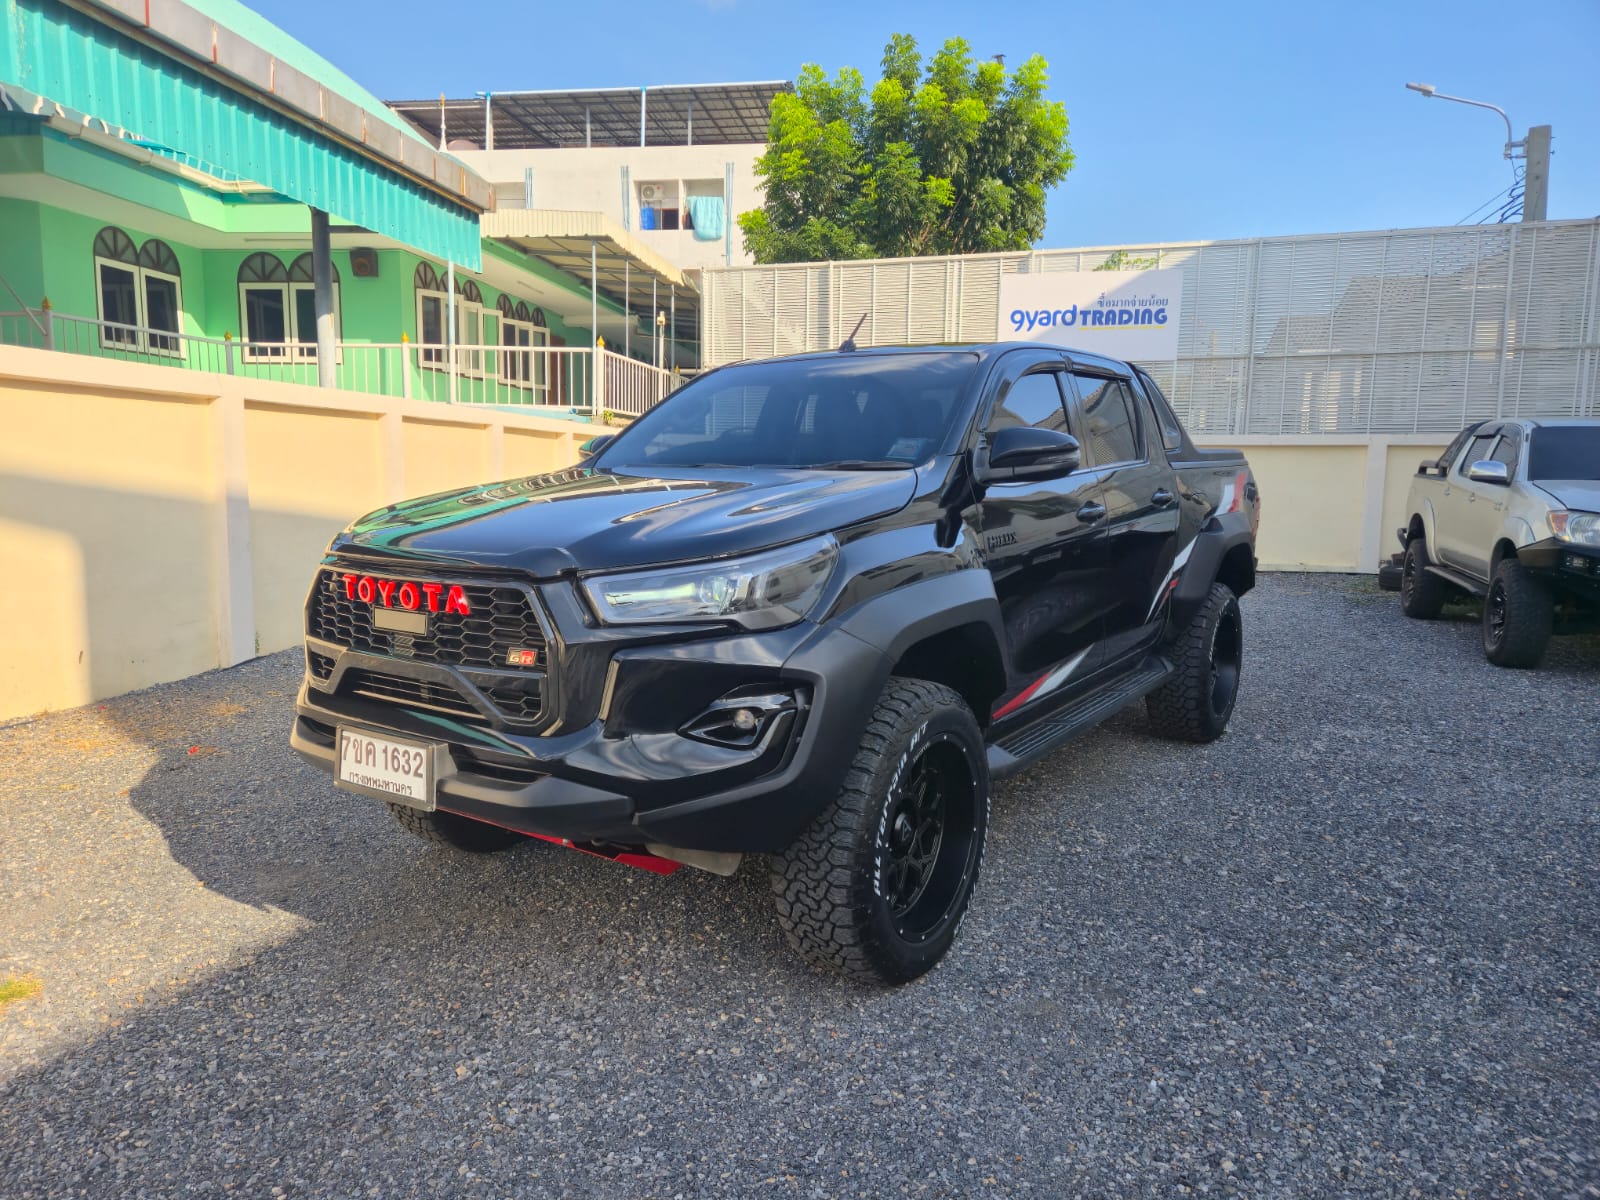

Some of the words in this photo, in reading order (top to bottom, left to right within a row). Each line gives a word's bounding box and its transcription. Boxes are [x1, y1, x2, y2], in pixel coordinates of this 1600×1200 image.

[1097, 291, 1169, 308] ซื้อมากจ่ายน้อย
[1010, 304, 1078, 332] 9yard
[1080, 308, 1168, 326] TRADING
[343, 573, 471, 616] TOYOTA
[509, 650, 534, 665] GR
[382, 745, 424, 779] 1632
[349, 771, 413, 796] กรงเทพมหานคร
